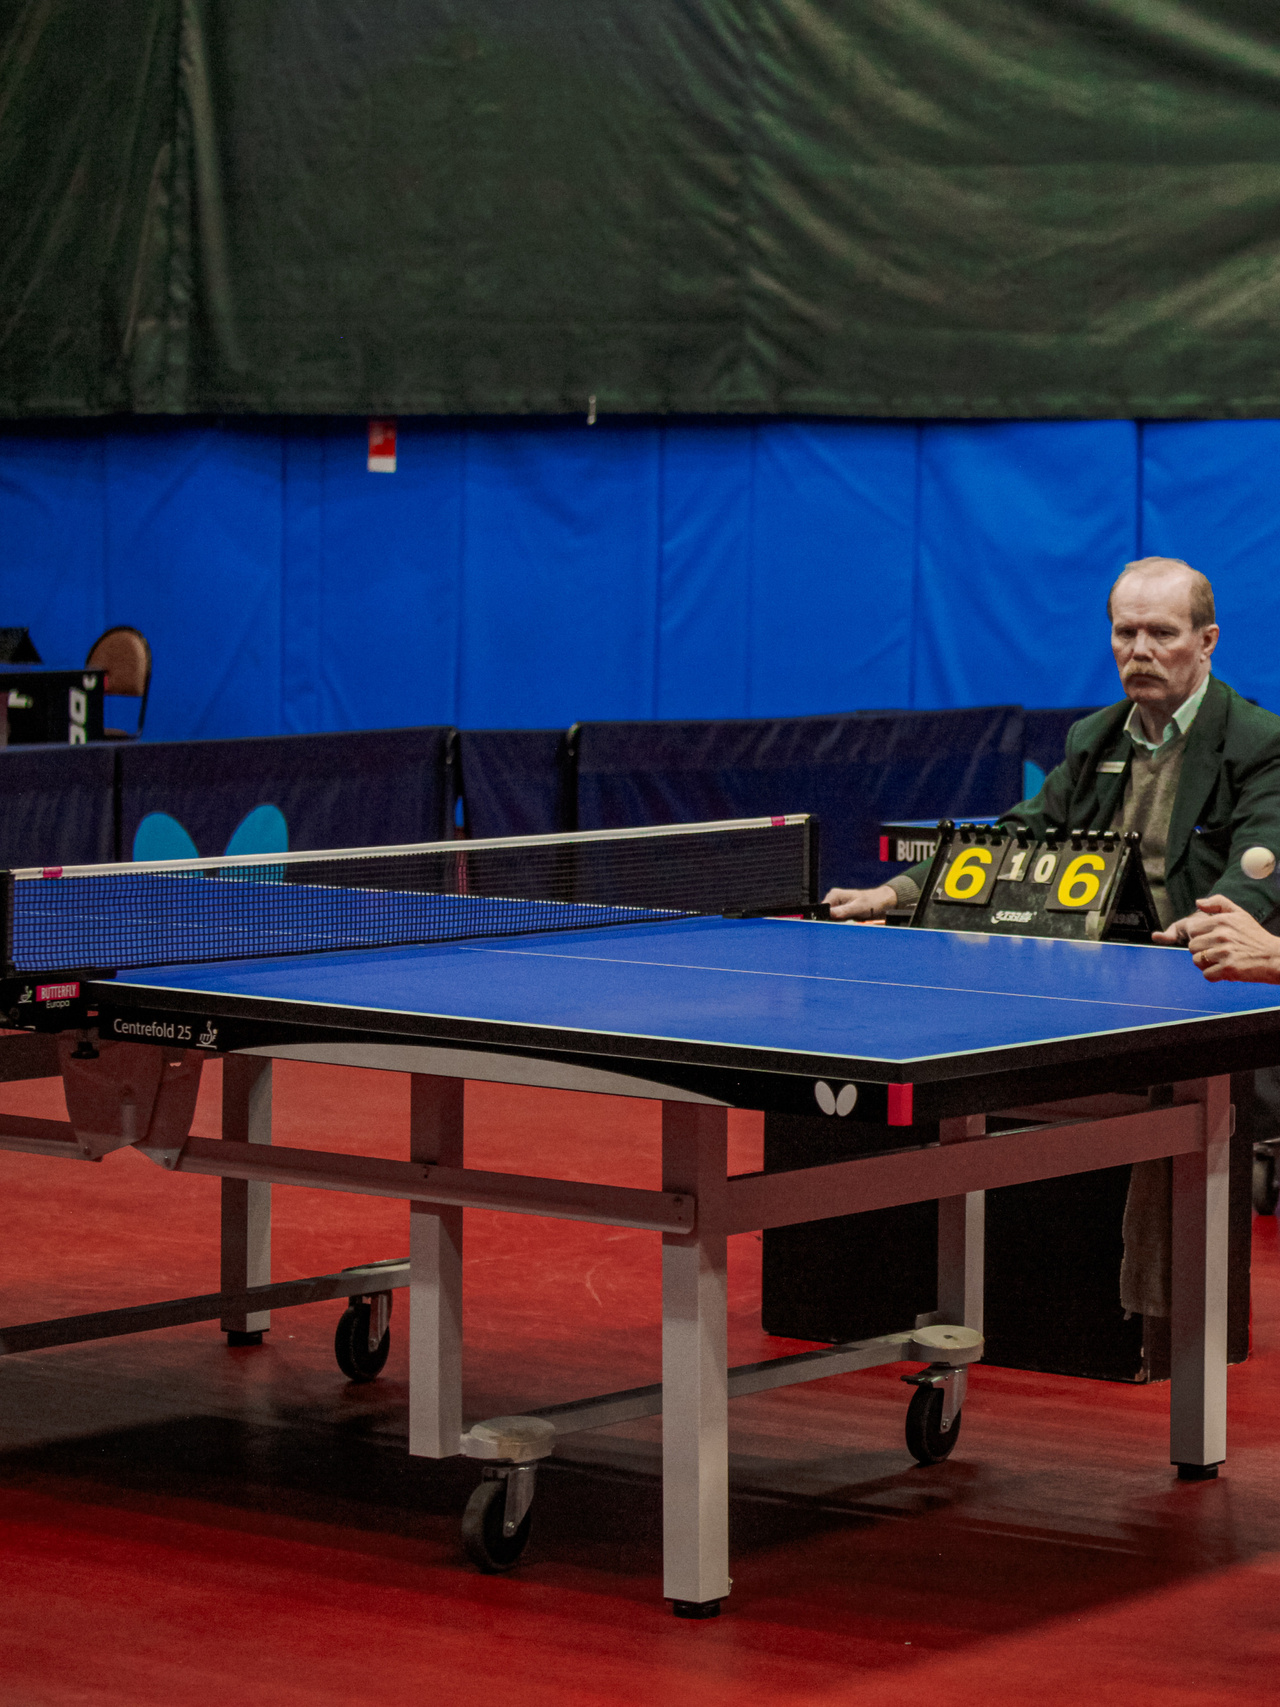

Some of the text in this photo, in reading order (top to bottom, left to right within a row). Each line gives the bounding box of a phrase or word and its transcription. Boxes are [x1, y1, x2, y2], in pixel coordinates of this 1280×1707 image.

[944, 847, 1106, 907] 6 1 0 6
[40, 984, 77, 1000] BUTTERFLY
[45, 999, 70, 1010] Europa
[113, 1018, 192, 1040] Centrefold 25
